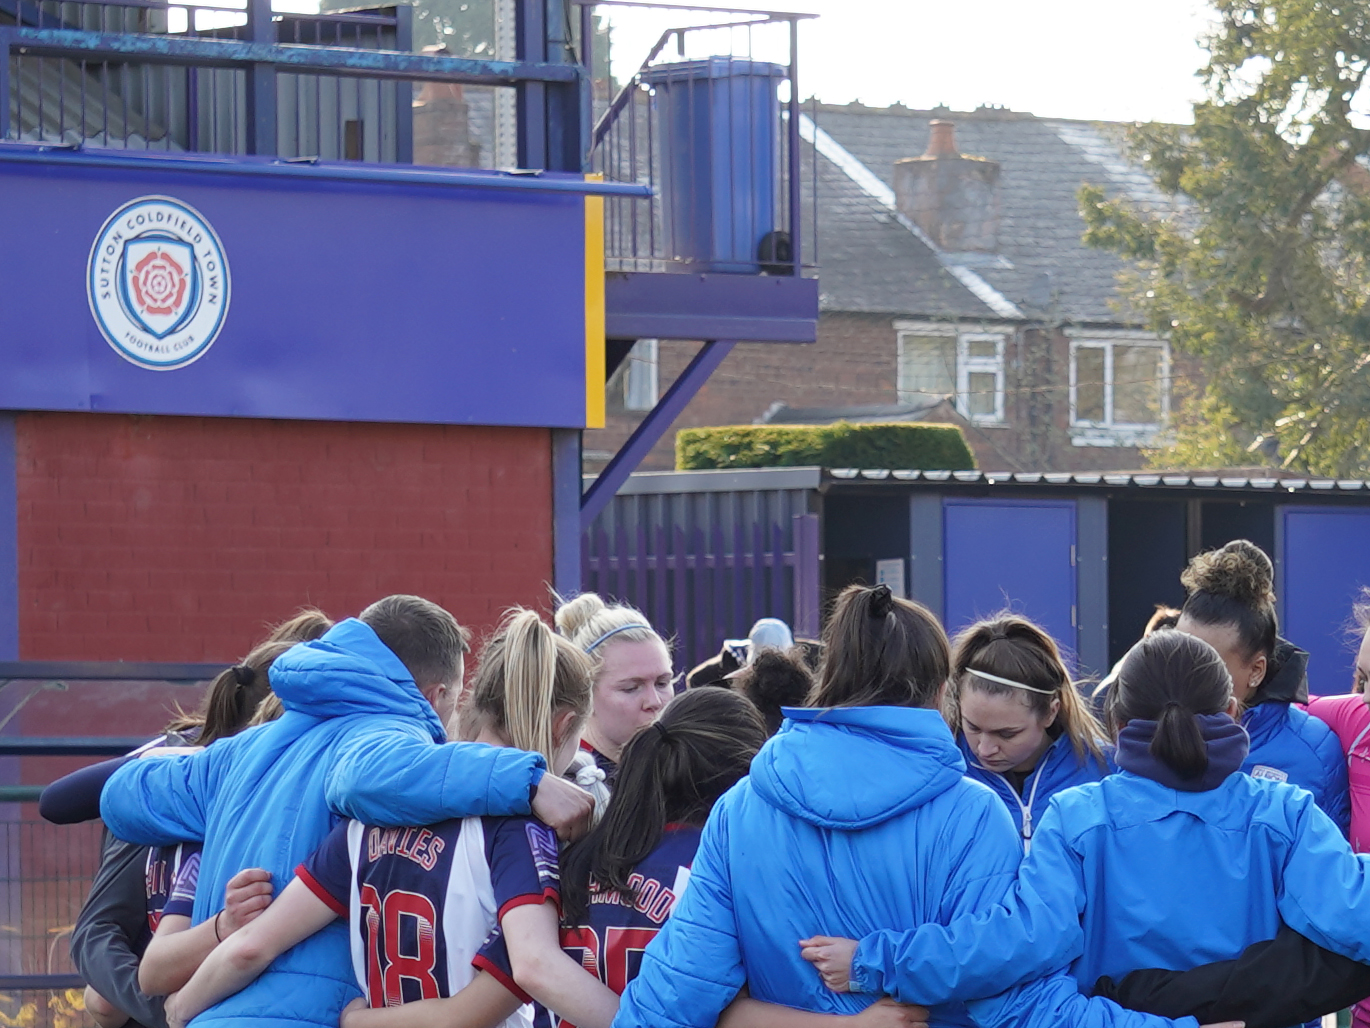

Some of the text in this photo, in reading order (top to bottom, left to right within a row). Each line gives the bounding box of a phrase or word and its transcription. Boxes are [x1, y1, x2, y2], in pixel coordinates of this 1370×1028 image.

[100, 210, 218, 306] SUTTON COLDFIELD TOWN
[124, 331, 196, 354] FOOTBALL CLUB
[368, 825, 445, 871] DAVIES
[360, 883, 440, 1009] 18
